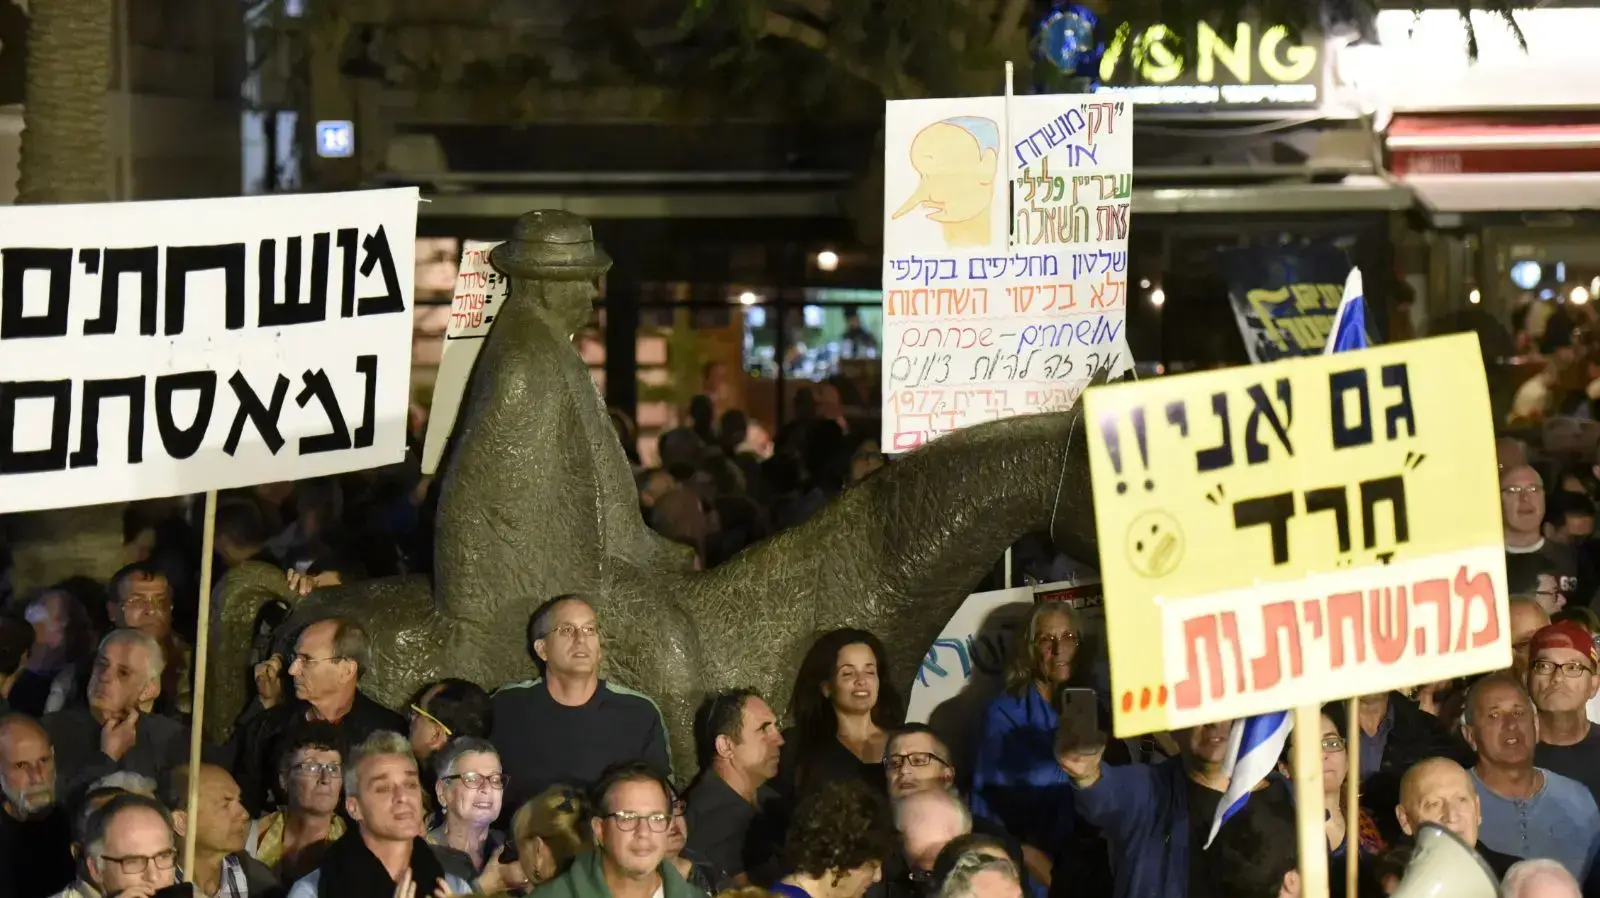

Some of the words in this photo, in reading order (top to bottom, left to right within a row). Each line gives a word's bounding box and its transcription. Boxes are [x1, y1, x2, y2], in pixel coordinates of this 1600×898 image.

[1014, 108, 1086, 169] מושחת
[1066, 144, 1098, 167] או
[1072, 173, 1132, 206] עבריין
[1096, 203, 1130, 242] זאת
[889, 255, 959, 287] בקלפי
[967, 253, 1059, 281] מחליפים
[1071, 249, 1127, 280] שלטון
[1, 223, 406, 340] מושחתים
[1005, 283, 1078, 312] בכיסוי
[1090, 272, 1126, 308] ולא
[887, 287, 989, 316] השחיתות
[896, 327, 995, 356] שכחתם
[1017, 315, 1124, 354] מושחתים
[969, 348, 1042, 381] להיות
[1043, 354, 1074, 379] זה
[0, 354, 378, 476] נמאסתם
[887, 390, 946, 414] 1977
[1328, 362, 1417, 451] גם
